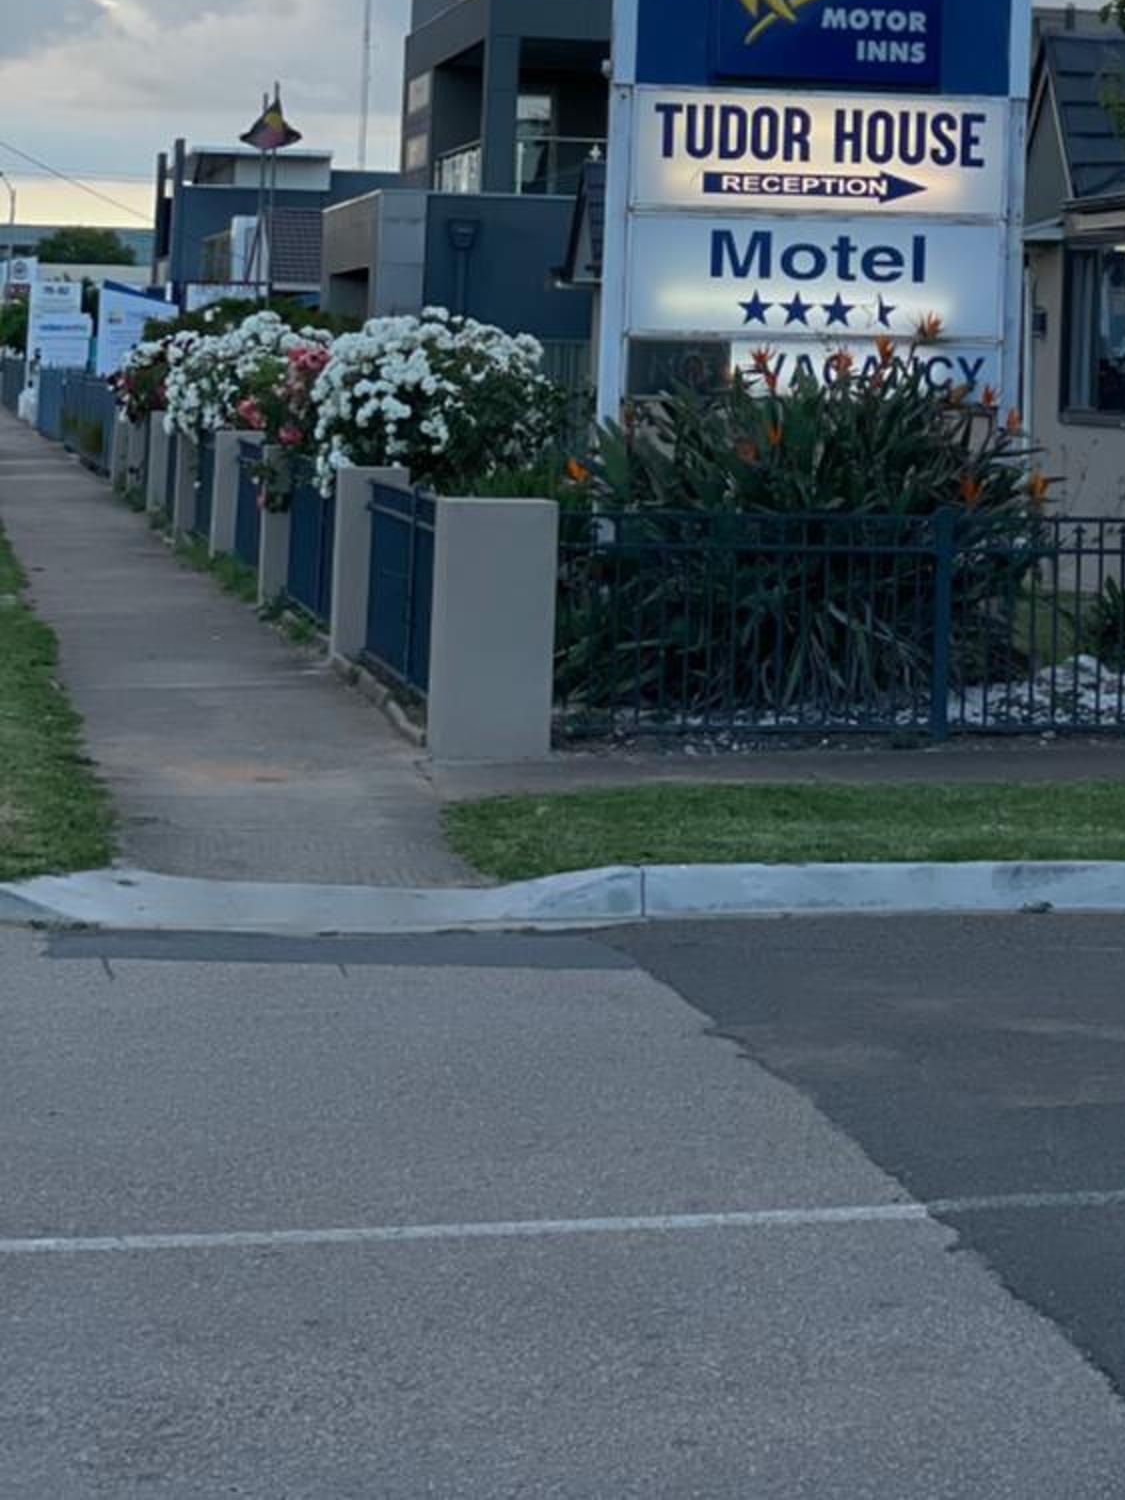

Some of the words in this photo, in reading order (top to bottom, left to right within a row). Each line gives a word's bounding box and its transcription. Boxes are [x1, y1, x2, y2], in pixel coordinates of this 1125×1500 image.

[821, 7, 926, 32] MOTOR
[856, 40, 926, 63] INNS
[655, 103, 810, 162] TUDOR
[834, 109, 986, 168] HOUSE
[721, 174, 889, 196] RECEPTION
[710, 229, 926, 283] Motel
